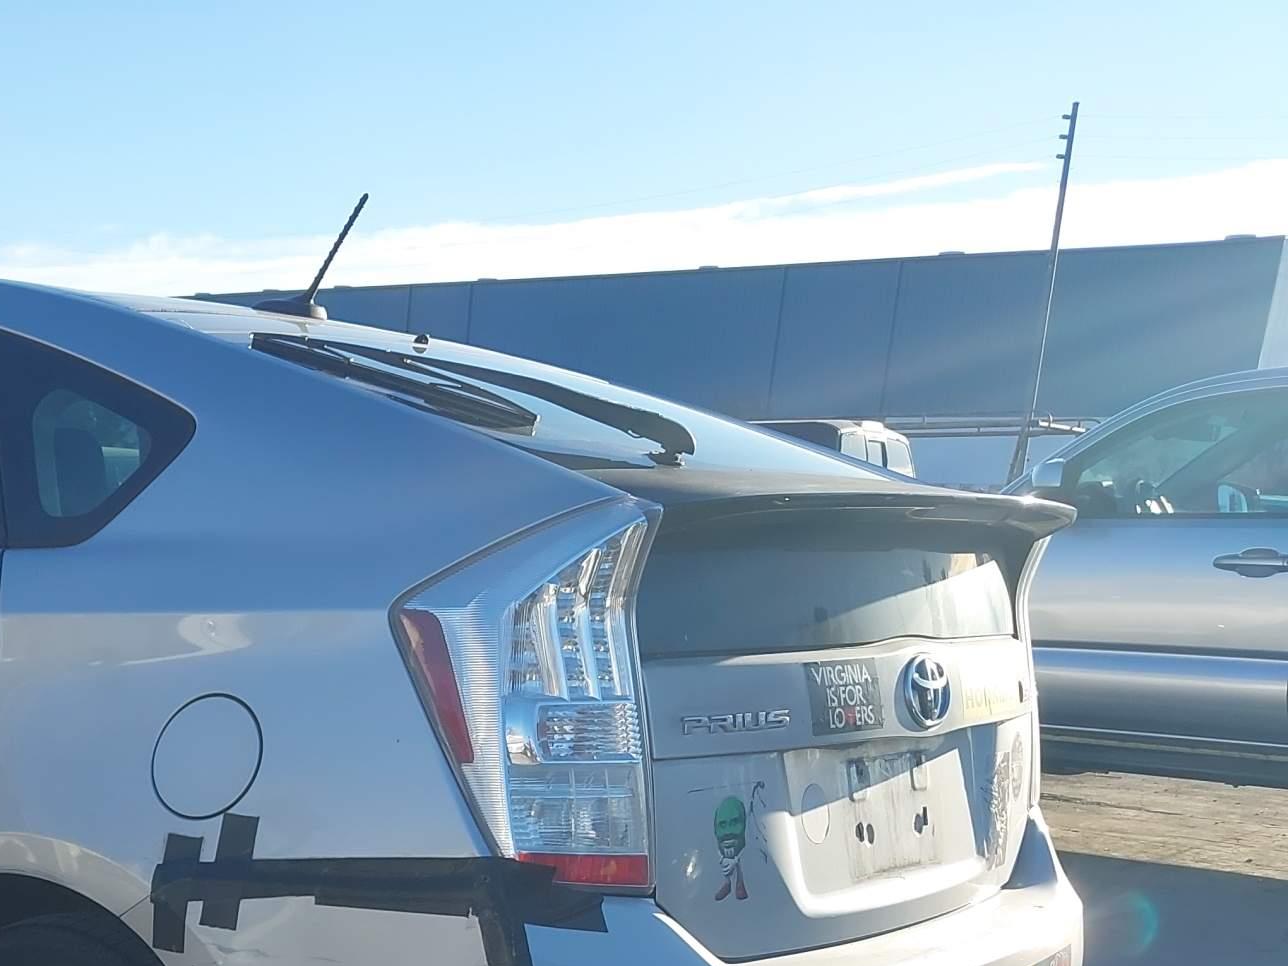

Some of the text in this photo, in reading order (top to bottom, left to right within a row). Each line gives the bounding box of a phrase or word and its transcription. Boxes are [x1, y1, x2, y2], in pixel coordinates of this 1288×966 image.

[811, 663, 872, 686] VIRGINIA
[827, 685, 867, 707] IS FOR
[681, 709, 791, 735] PRIUS
[829, 705, 875, 728] LOERS
